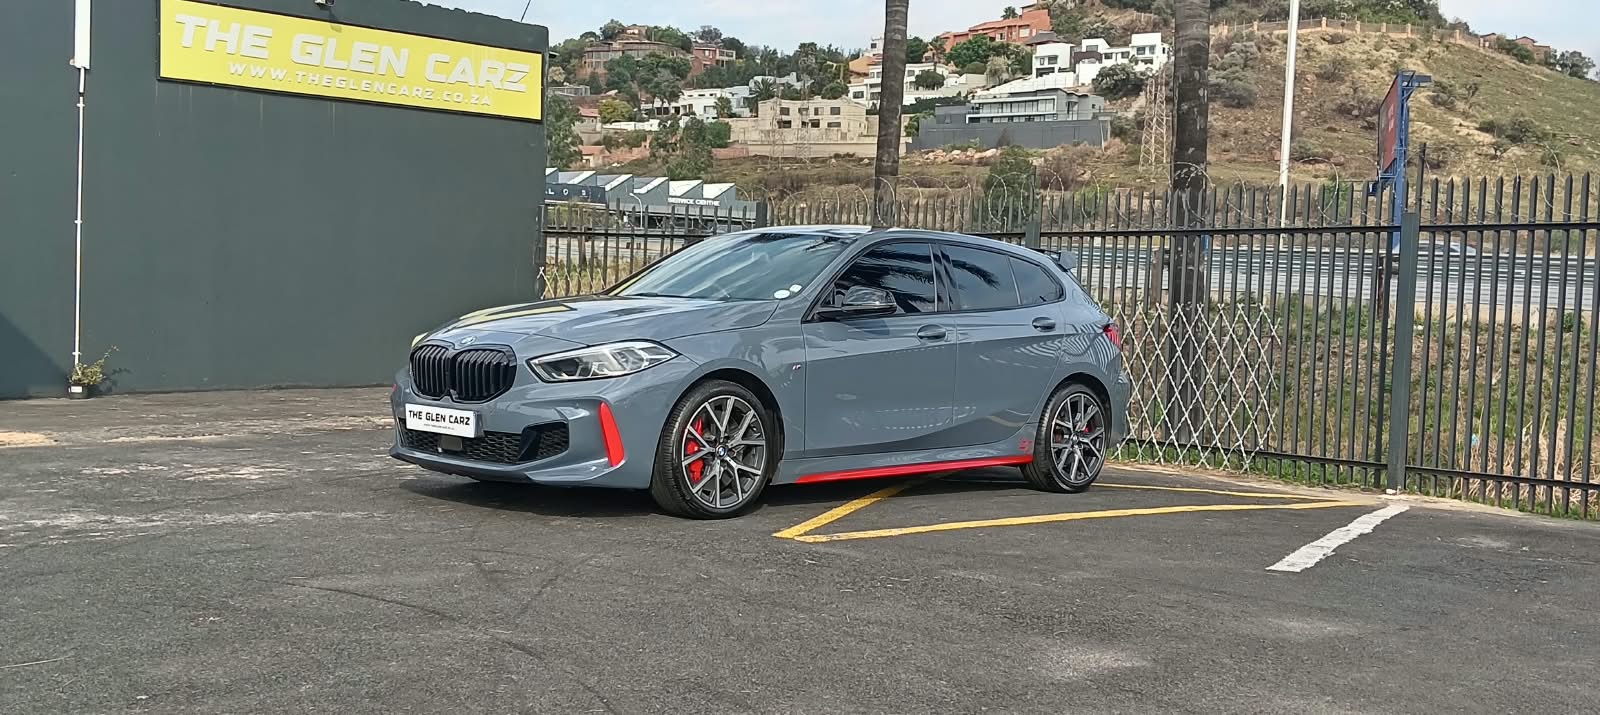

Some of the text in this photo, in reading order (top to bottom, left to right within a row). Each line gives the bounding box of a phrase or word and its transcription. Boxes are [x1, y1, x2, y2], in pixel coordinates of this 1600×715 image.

[176, 13, 531, 93] THE GLEN CARZ
[228, 61, 492, 106] WWW.THEGLENCARZ.CO.ZA
[409, 410, 470, 425] THE GLEN CARZ
